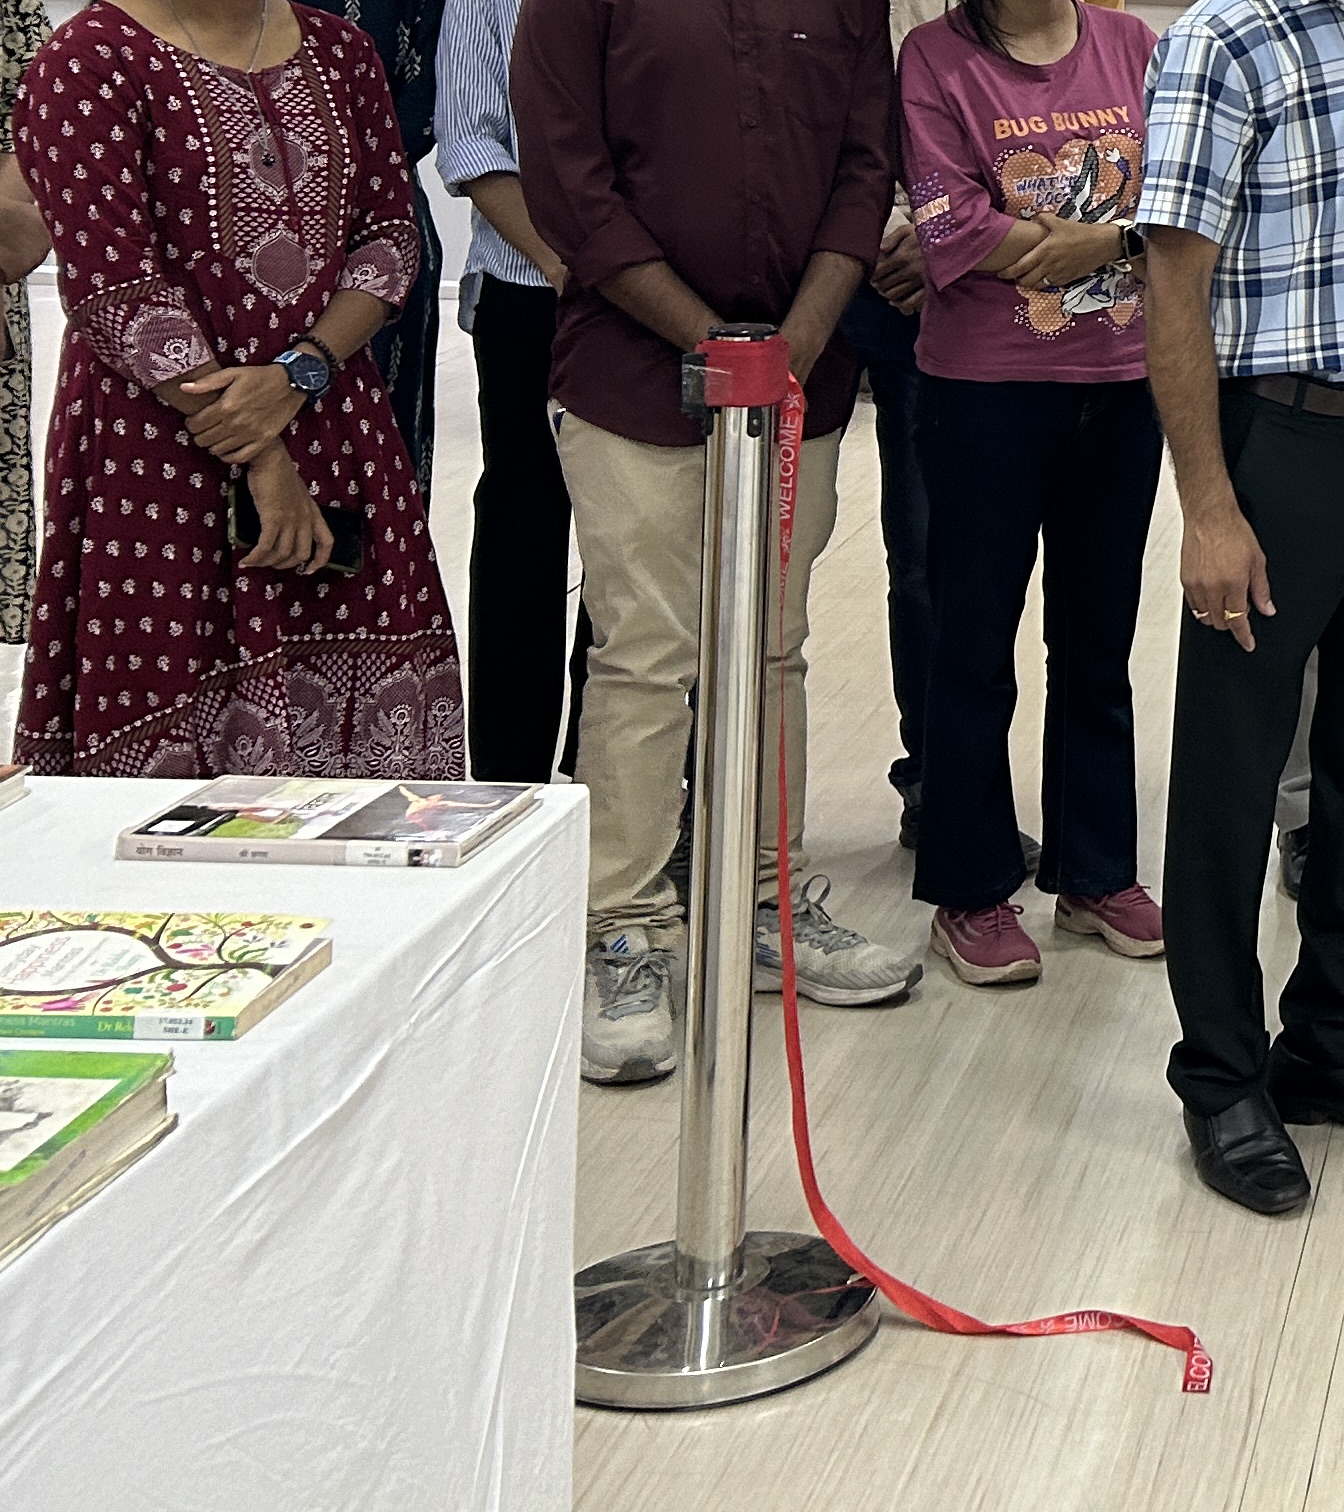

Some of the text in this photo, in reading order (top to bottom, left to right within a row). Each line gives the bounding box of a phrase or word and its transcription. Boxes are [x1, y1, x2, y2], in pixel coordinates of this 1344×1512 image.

[994, 106, 1131, 140] BUG BUNNY
[779, 414, 798, 520] WELCOME
